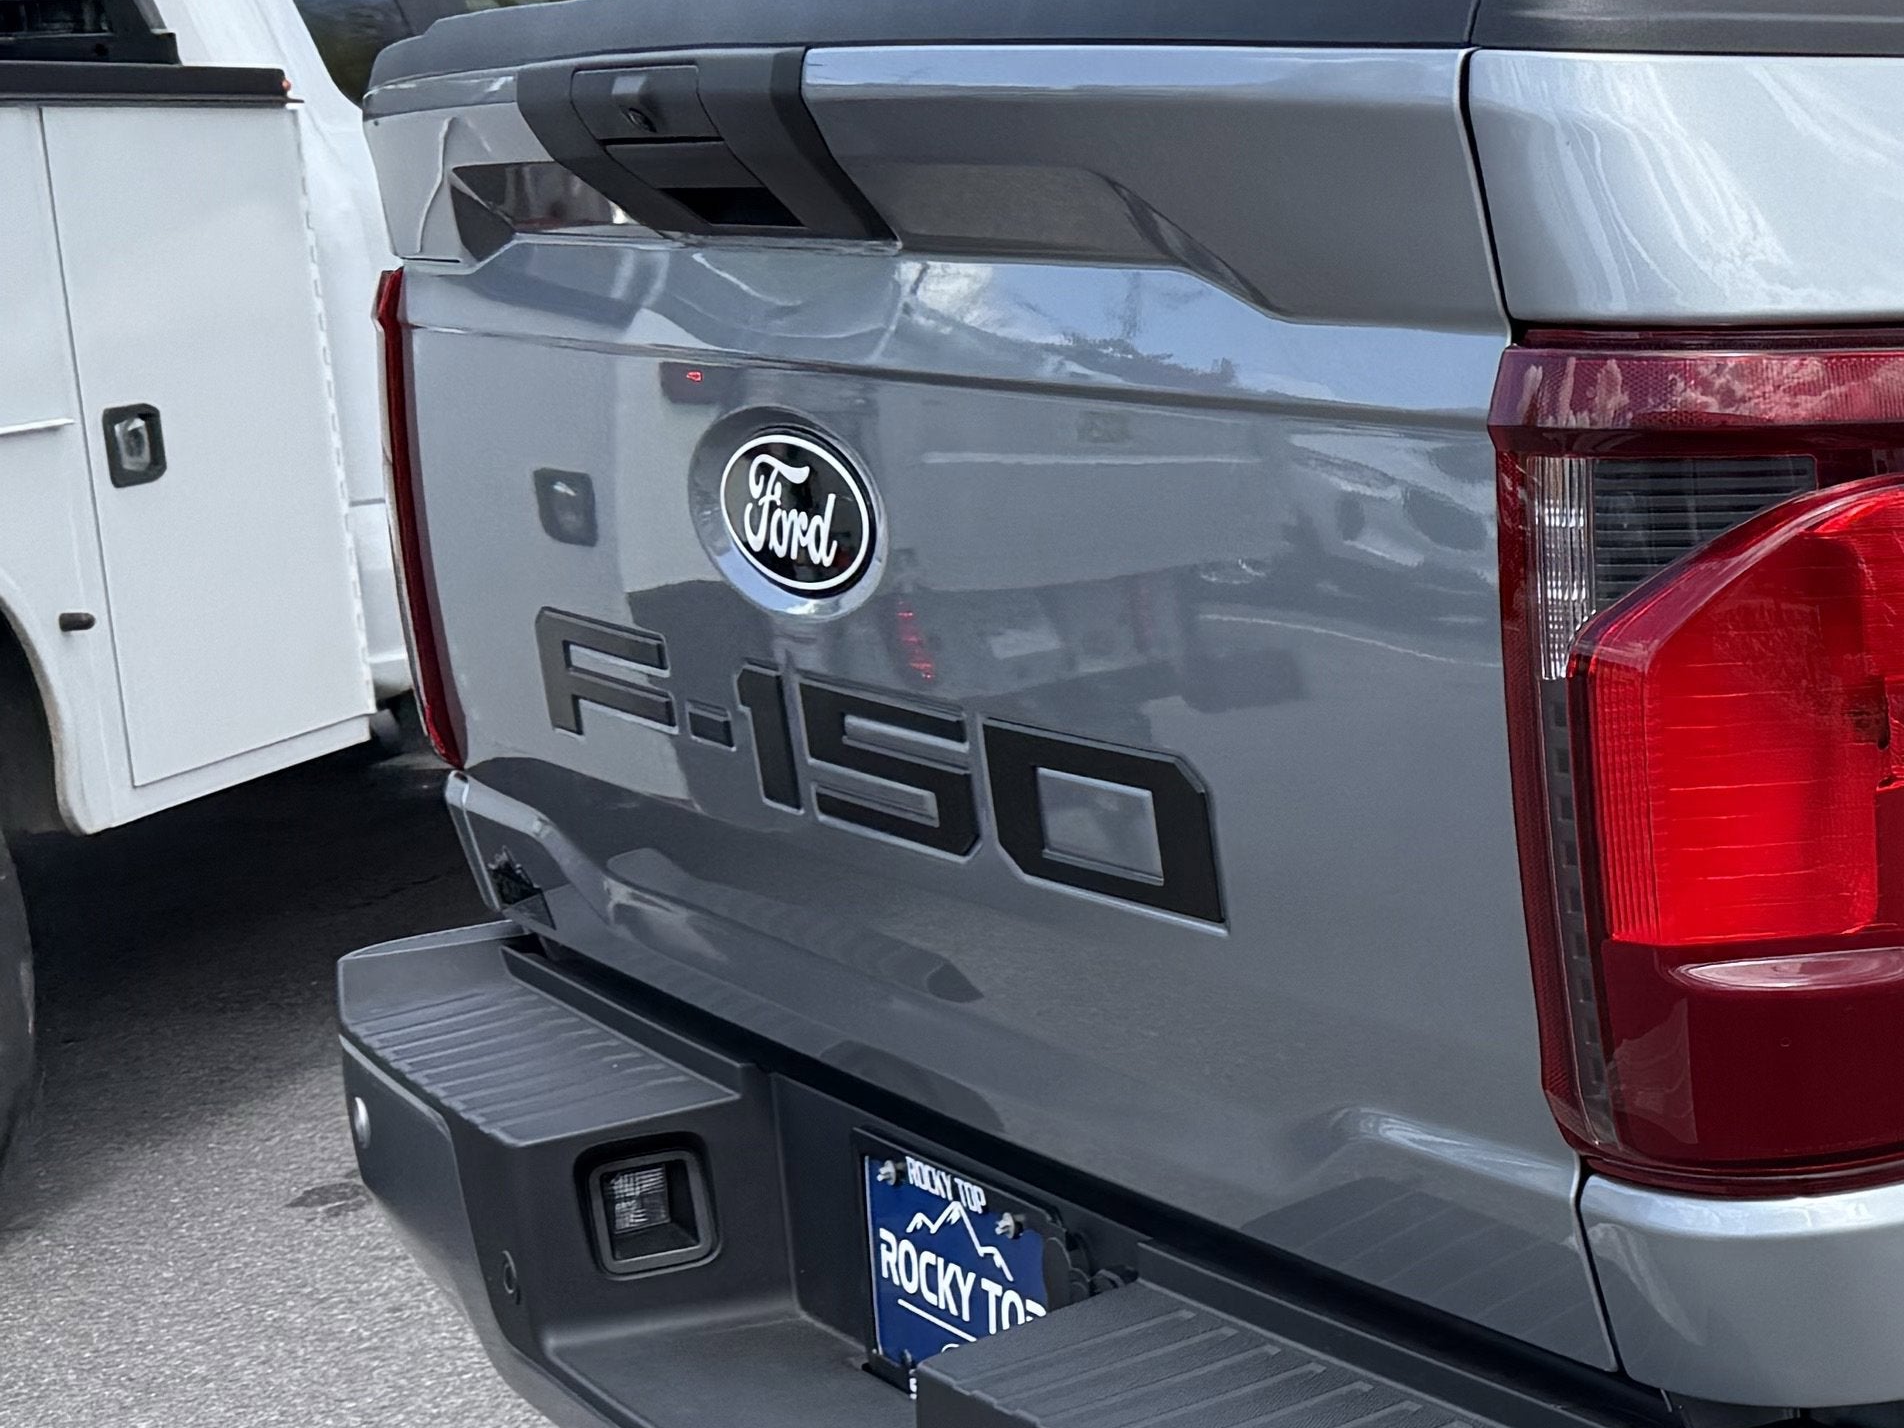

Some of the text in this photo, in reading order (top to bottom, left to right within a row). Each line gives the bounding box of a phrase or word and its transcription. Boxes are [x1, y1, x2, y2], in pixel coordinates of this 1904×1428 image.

[743, 453, 839, 568] Ford
[534, 606, 1230, 936] F-150
[905, 1156, 986, 1214] ROCKY TOP
[879, 1227, 976, 1321] ROCKY
